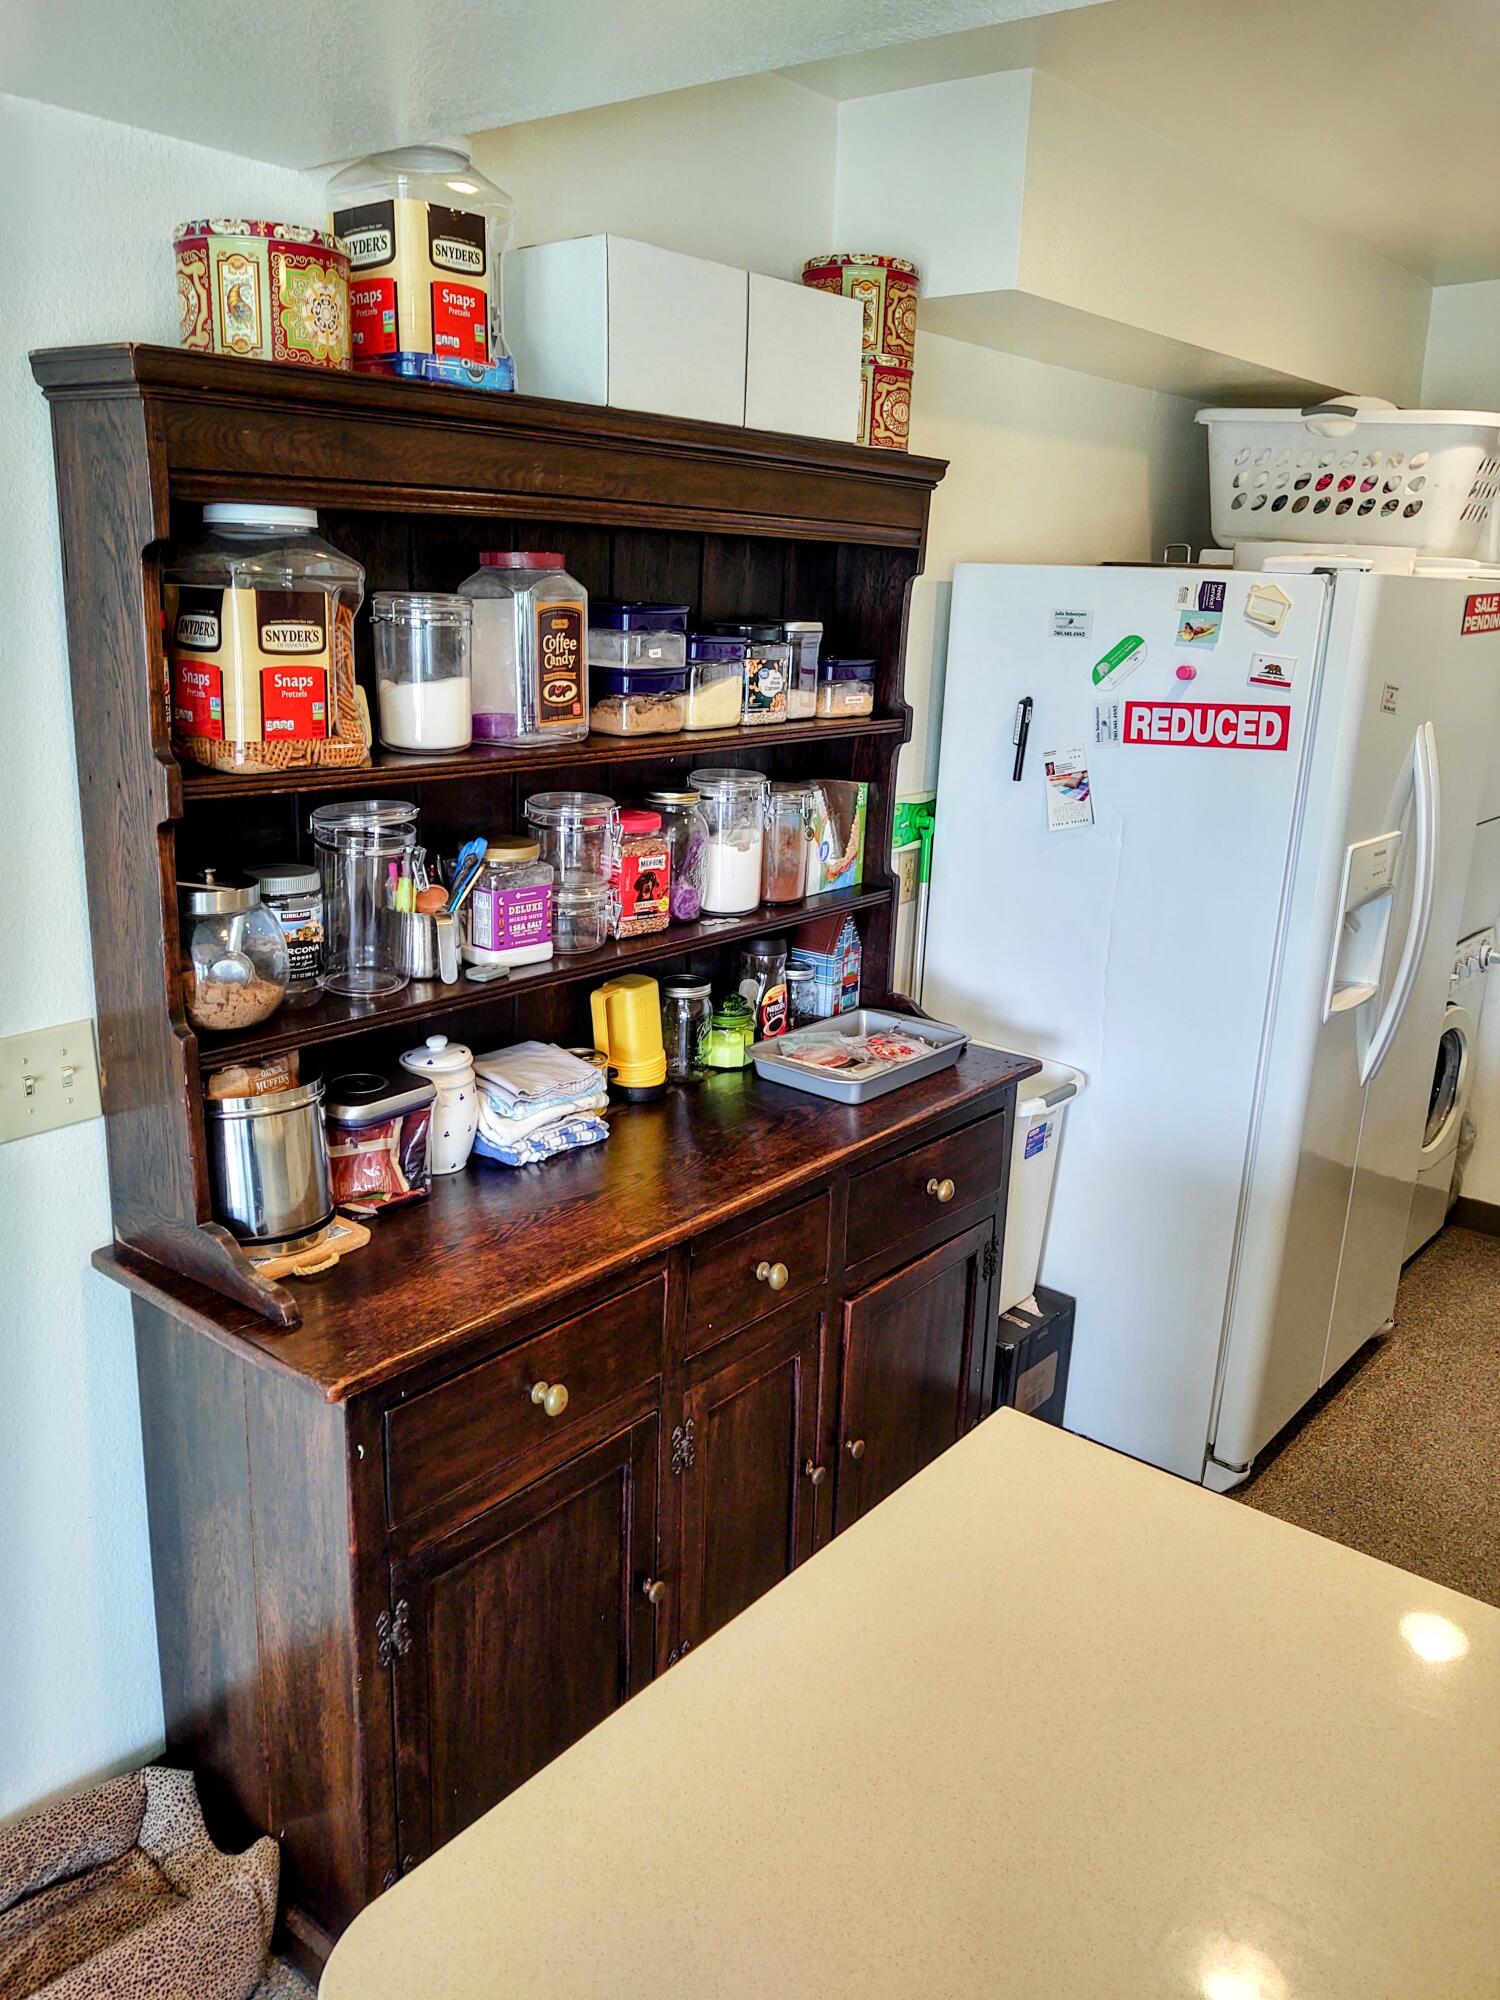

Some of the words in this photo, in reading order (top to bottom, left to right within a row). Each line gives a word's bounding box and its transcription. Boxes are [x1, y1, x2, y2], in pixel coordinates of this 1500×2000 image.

[349, 235, 387, 255] YDER'S
[435, 244, 480, 264] SNYDER'S
[350, 289, 382, 307] Snaps
[443, 289, 475, 310] Snaps
[356, 307, 377, 317] Pretzels
[448, 306, 471, 318] Pretzels
[1209, 584, 1217, 609] Service?
[1215, 584, 1224, 601] Need
[1475, 597, 1499, 613] SALE
[178, 619, 216, 637] SNYDER'S
[1464, 613, 1500, 632] PENDIN
[265, 629, 319, 643] SNYDER'S
[543, 632, 577, 654] Coffee
[544, 650, 575, 669] Candy
[182, 668, 210, 689] Snaps
[274, 674, 313, 690] Snaps
[187, 688, 206, 698] Pretzels
[281, 690, 308, 698] Pretzels
[1130, 706, 1283, 746] REDUCED
[509, 902, 543, 915] DELUXE
[509, 915, 527, 923] MIXED
[513, 923, 526, 932] SEA
[526, 920, 543, 929] SALT
[288, 944, 319, 955] RCONA
[255, 1073, 289, 1094] MUFFINS
